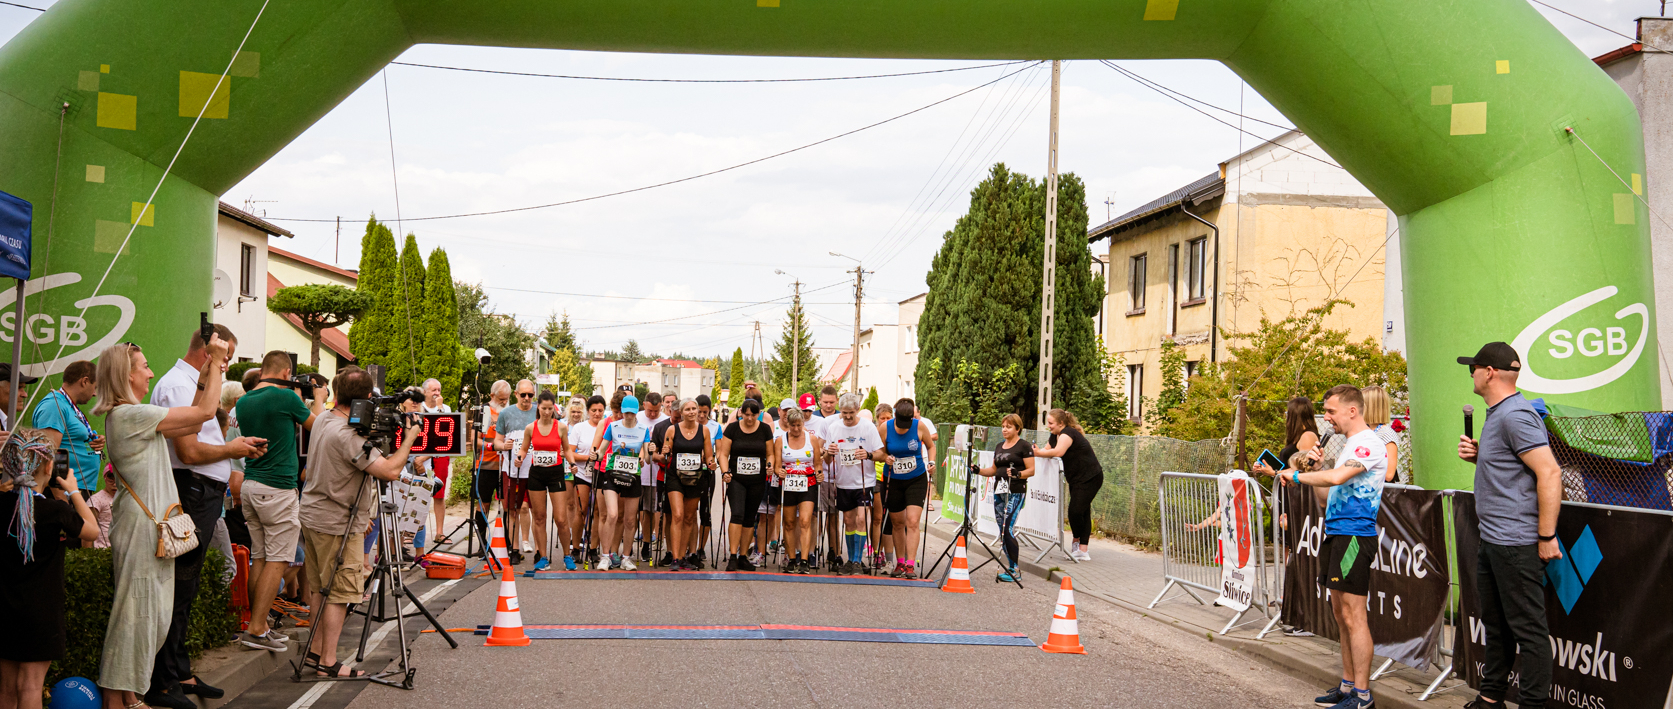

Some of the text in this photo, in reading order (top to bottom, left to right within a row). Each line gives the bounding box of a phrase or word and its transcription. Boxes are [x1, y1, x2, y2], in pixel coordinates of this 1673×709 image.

[0, 311, 88, 346] SGB
[1548, 326, 1628, 359] SGB
[537, 456, 553, 464] 323
[618, 461, 634, 470] 303
[741, 462, 757, 471] 325
[897, 461, 913, 470] 310
[788, 479, 804, 487] 314
[1553, 683, 1566, 703] IN
